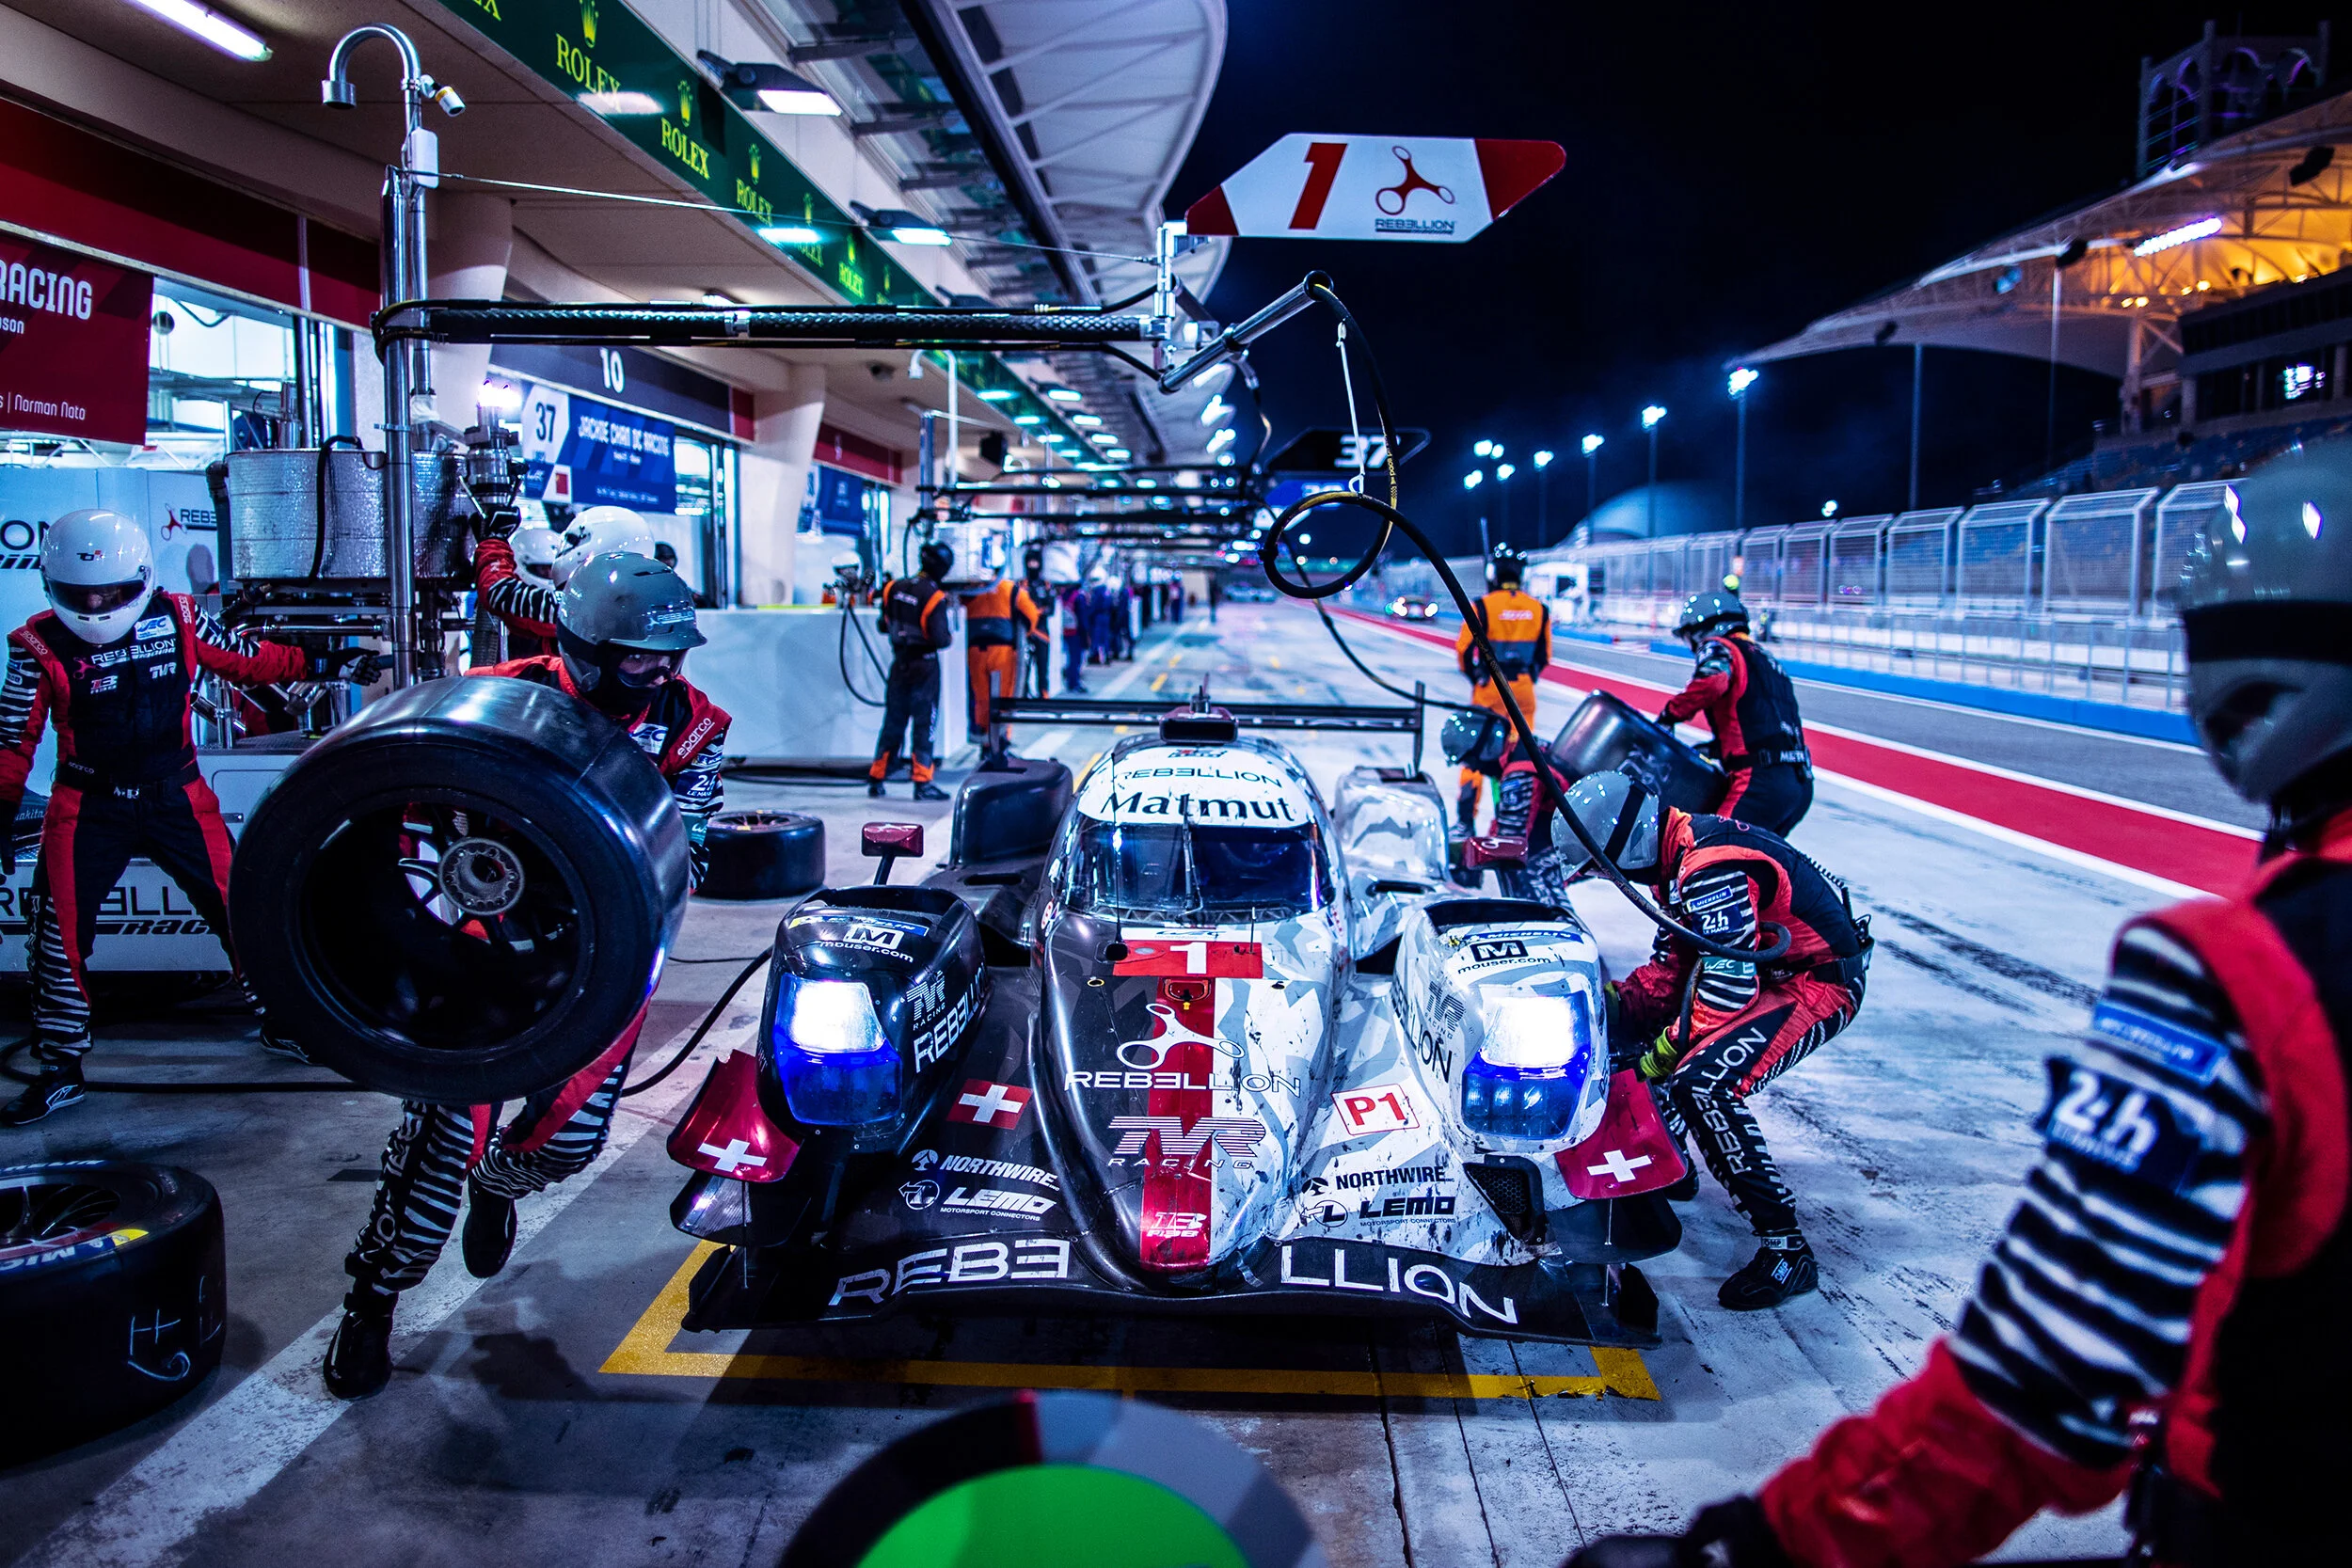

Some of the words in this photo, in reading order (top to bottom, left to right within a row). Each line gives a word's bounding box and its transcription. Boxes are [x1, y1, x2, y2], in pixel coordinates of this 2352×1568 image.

[555, 32, 622, 113] ROLEX
[660, 117, 710, 180] ROLEX
[1288, 142, 1348, 230] 1
[736, 177, 773, 228] ROLEX
[600, 346, 625, 394] 10
[14, 393, 57, 417] Norman
[60, 401, 87, 420] Nato
[535, 402, 557, 443] 37
[1333, 435, 1401, 468] 37
[150, 661, 177, 679] TVR
[1100, 791, 1295, 822] Matmut
[1696, 890, 1727, 907] MICHELIN
[1487, 931, 1572, 940] MICHELIN
[1701, 911, 1729, 930] 24h
[819, 941, 914, 963] mouser.com
[1169, 942, 1208, 974] 1
[1457, 956, 1551, 974] mouser.com
[1704, 958, 1736, 970] WEC
[913, 1001, 946, 1032] RACING
[1343, 1091, 1408, 1127] P1
[2053, 1068, 2158, 1157] 24h
[1107, 1116, 1267, 1158] TVR
[939, 1154, 1058, 1187] NORTHWIRE
[1107, 1158, 1254, 1170] RACING
[1336, 1165, 1445, 1191] NORTHWIRE
[939, 1207, 990, 1216] MOTORSPORT
[990, 1210, 1041, 1222] CONNECTORS
[943, 1186, 1057, 1215] LEMO
[1359, 1196, 1456, 1220] LEMO
[1763, 1238, 1782, 1248] OMP
[1280, 1244, 1518, 1325] LLION
[1774, 1260, 1789, 1282] OMP
